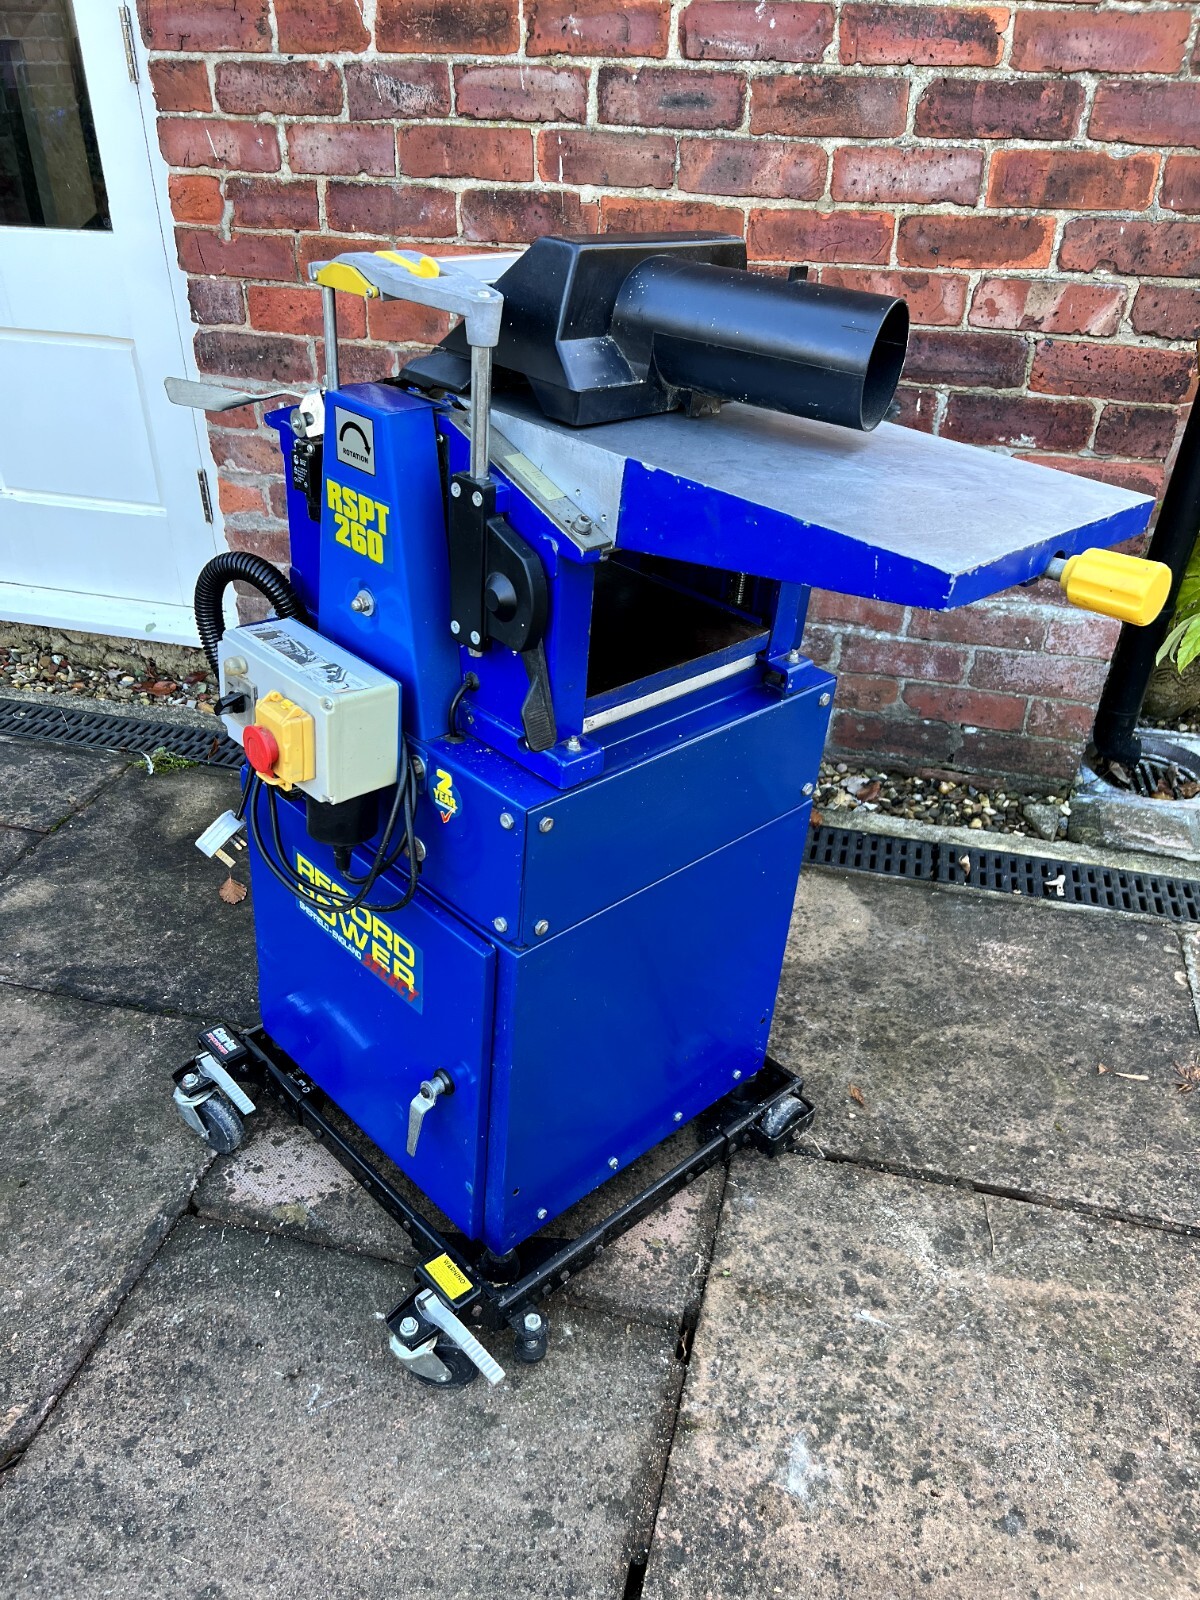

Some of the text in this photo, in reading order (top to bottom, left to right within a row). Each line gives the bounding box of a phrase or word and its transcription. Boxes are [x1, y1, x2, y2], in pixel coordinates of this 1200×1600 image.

[342, 447, 369, 464] ROTATION
[326, 478, 390, 535] RSPT
[334, 513, 384, 564] 260
[433, 787, 458, 810] YEAR
[436, 768, 453, 796] 2
[362, 953, 420, 1003] SELECT
